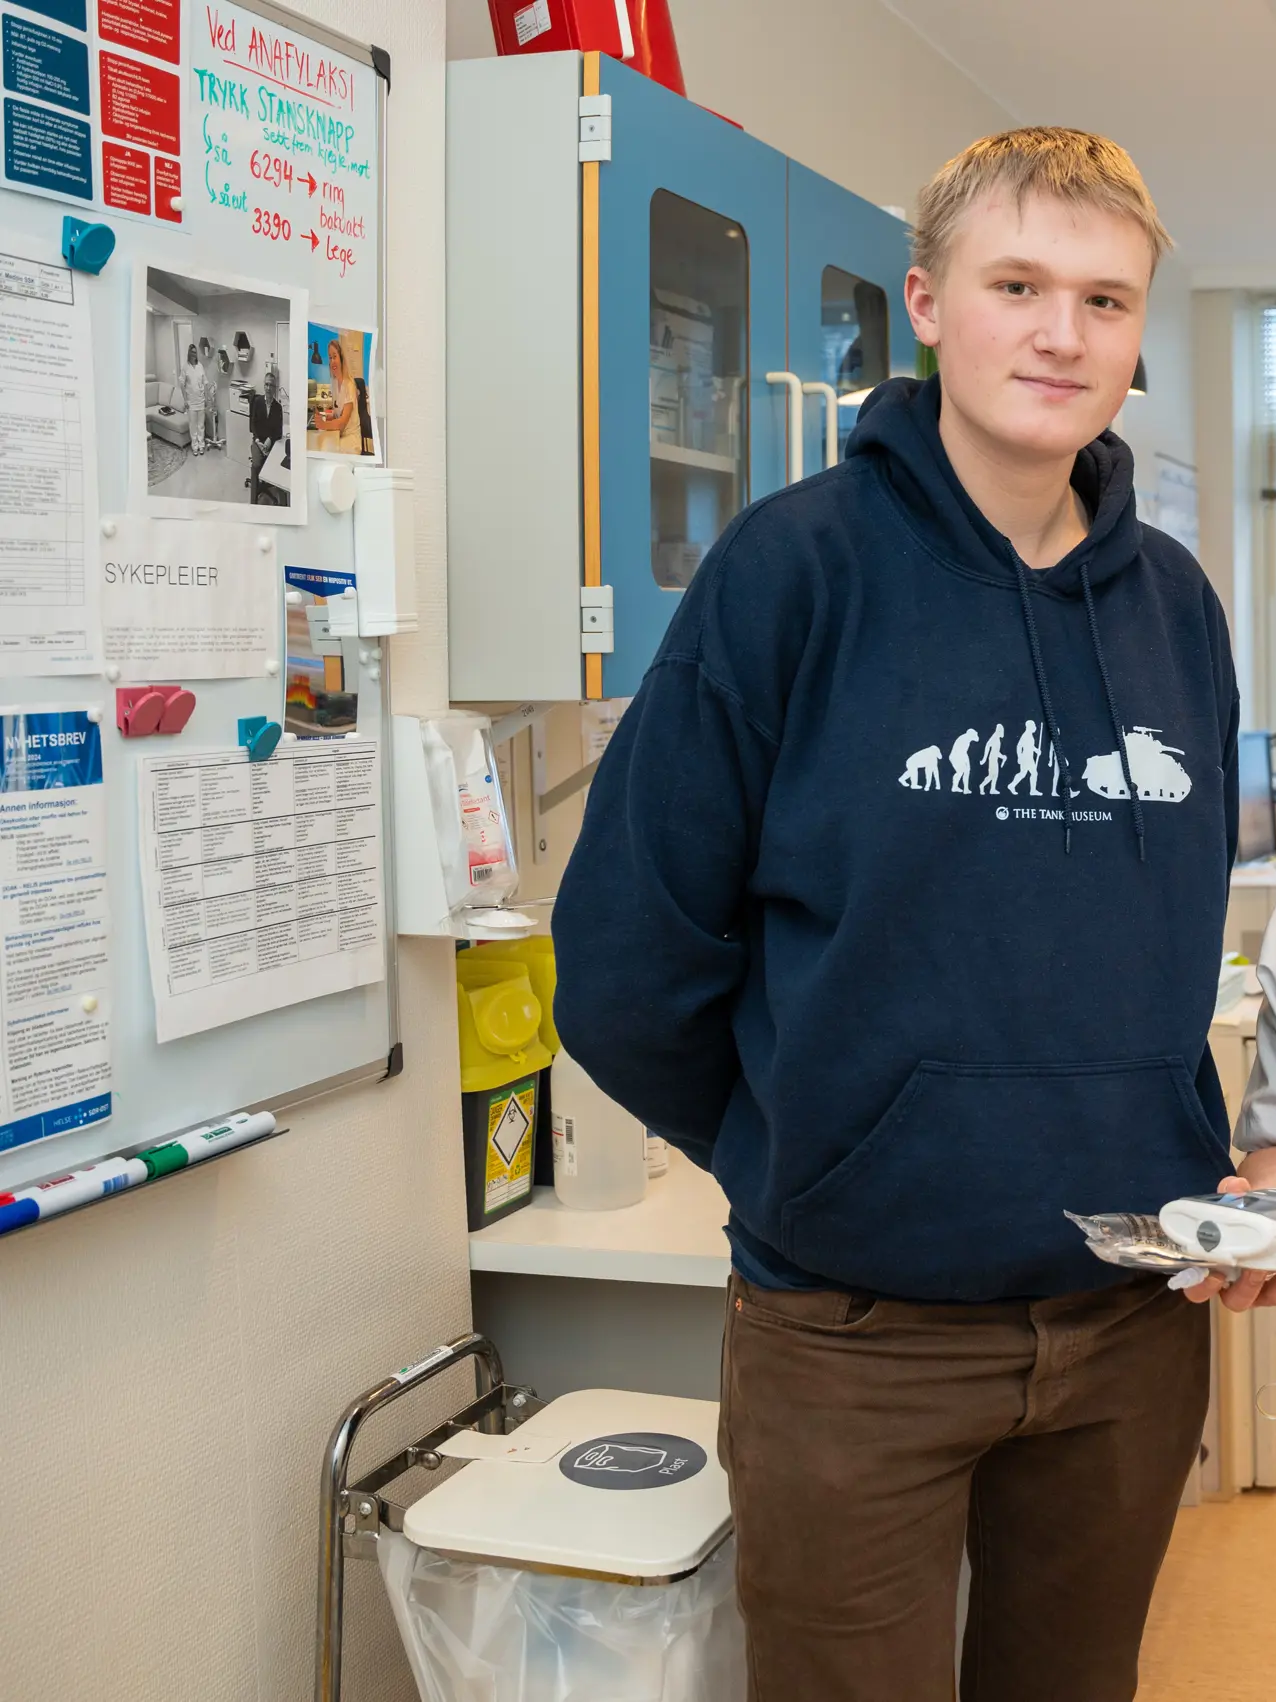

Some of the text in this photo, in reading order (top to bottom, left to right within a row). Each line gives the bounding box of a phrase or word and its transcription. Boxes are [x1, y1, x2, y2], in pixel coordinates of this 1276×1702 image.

[206, 5, 236, 53] Ved
[248, 26, 355, 112] ANAFYLAKSI
[192, 67, 250, 120] TRYKK
[257, 85, 355, 153] STANSKNAPP
[250, 149, 293, 193] 6294
[322, 181, 345, 218] ring
[251, 207, 292, 241] 3390
[326, 235, 357, 279] lege
[104, 562, 219, 587] SYKEPLEIER
[4, 732, 87, 750] NYHETSBREV
[0, 804, 26, 813] Annen
[1013, 808, 1036, 819] THE
[1039, 809, 1065, 820] TANK
[53, 1116, 72, 1128] HELSE
[658, 1458, 688, 1476] Plast
